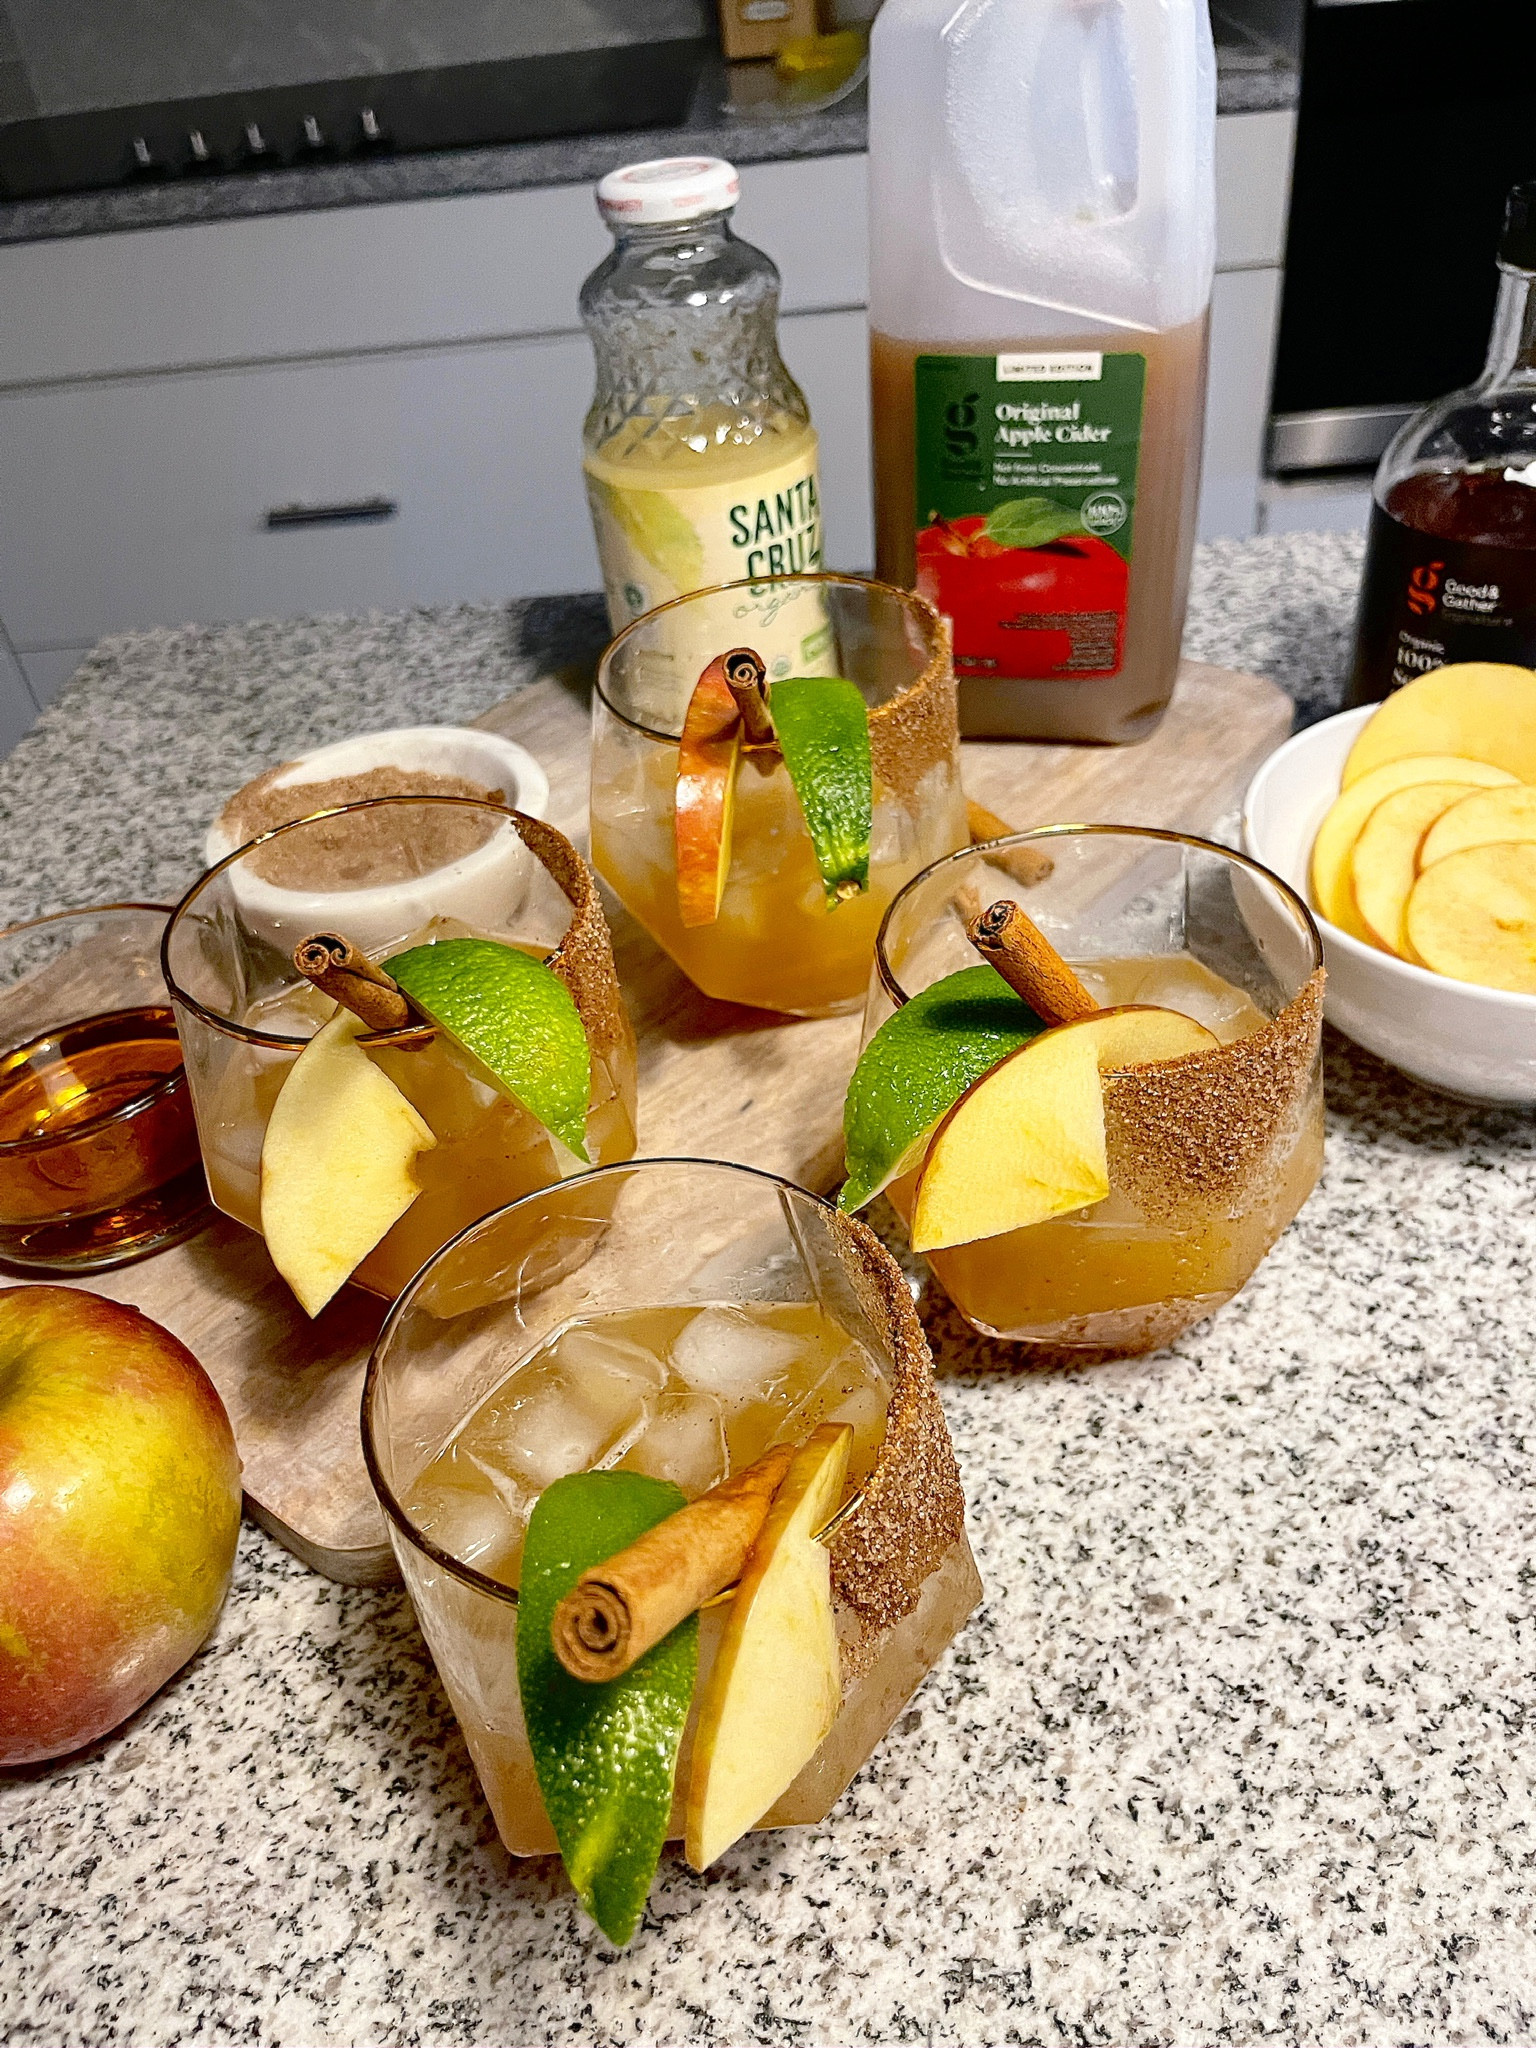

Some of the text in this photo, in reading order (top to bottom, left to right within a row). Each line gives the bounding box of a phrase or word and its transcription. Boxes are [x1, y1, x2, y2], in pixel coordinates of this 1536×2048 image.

[995, 400, 1081, 424] Original
[995, 423, 1112, 448] Apple Cider
[729, 473, 818, 548] SANTA
[747, 524, 821, 596] CRUZ
[1444, 578, 1500, 600] Good&
[1442, 592, 1498, 613] Gather
[1398, 629, 1445, 655] Organic
